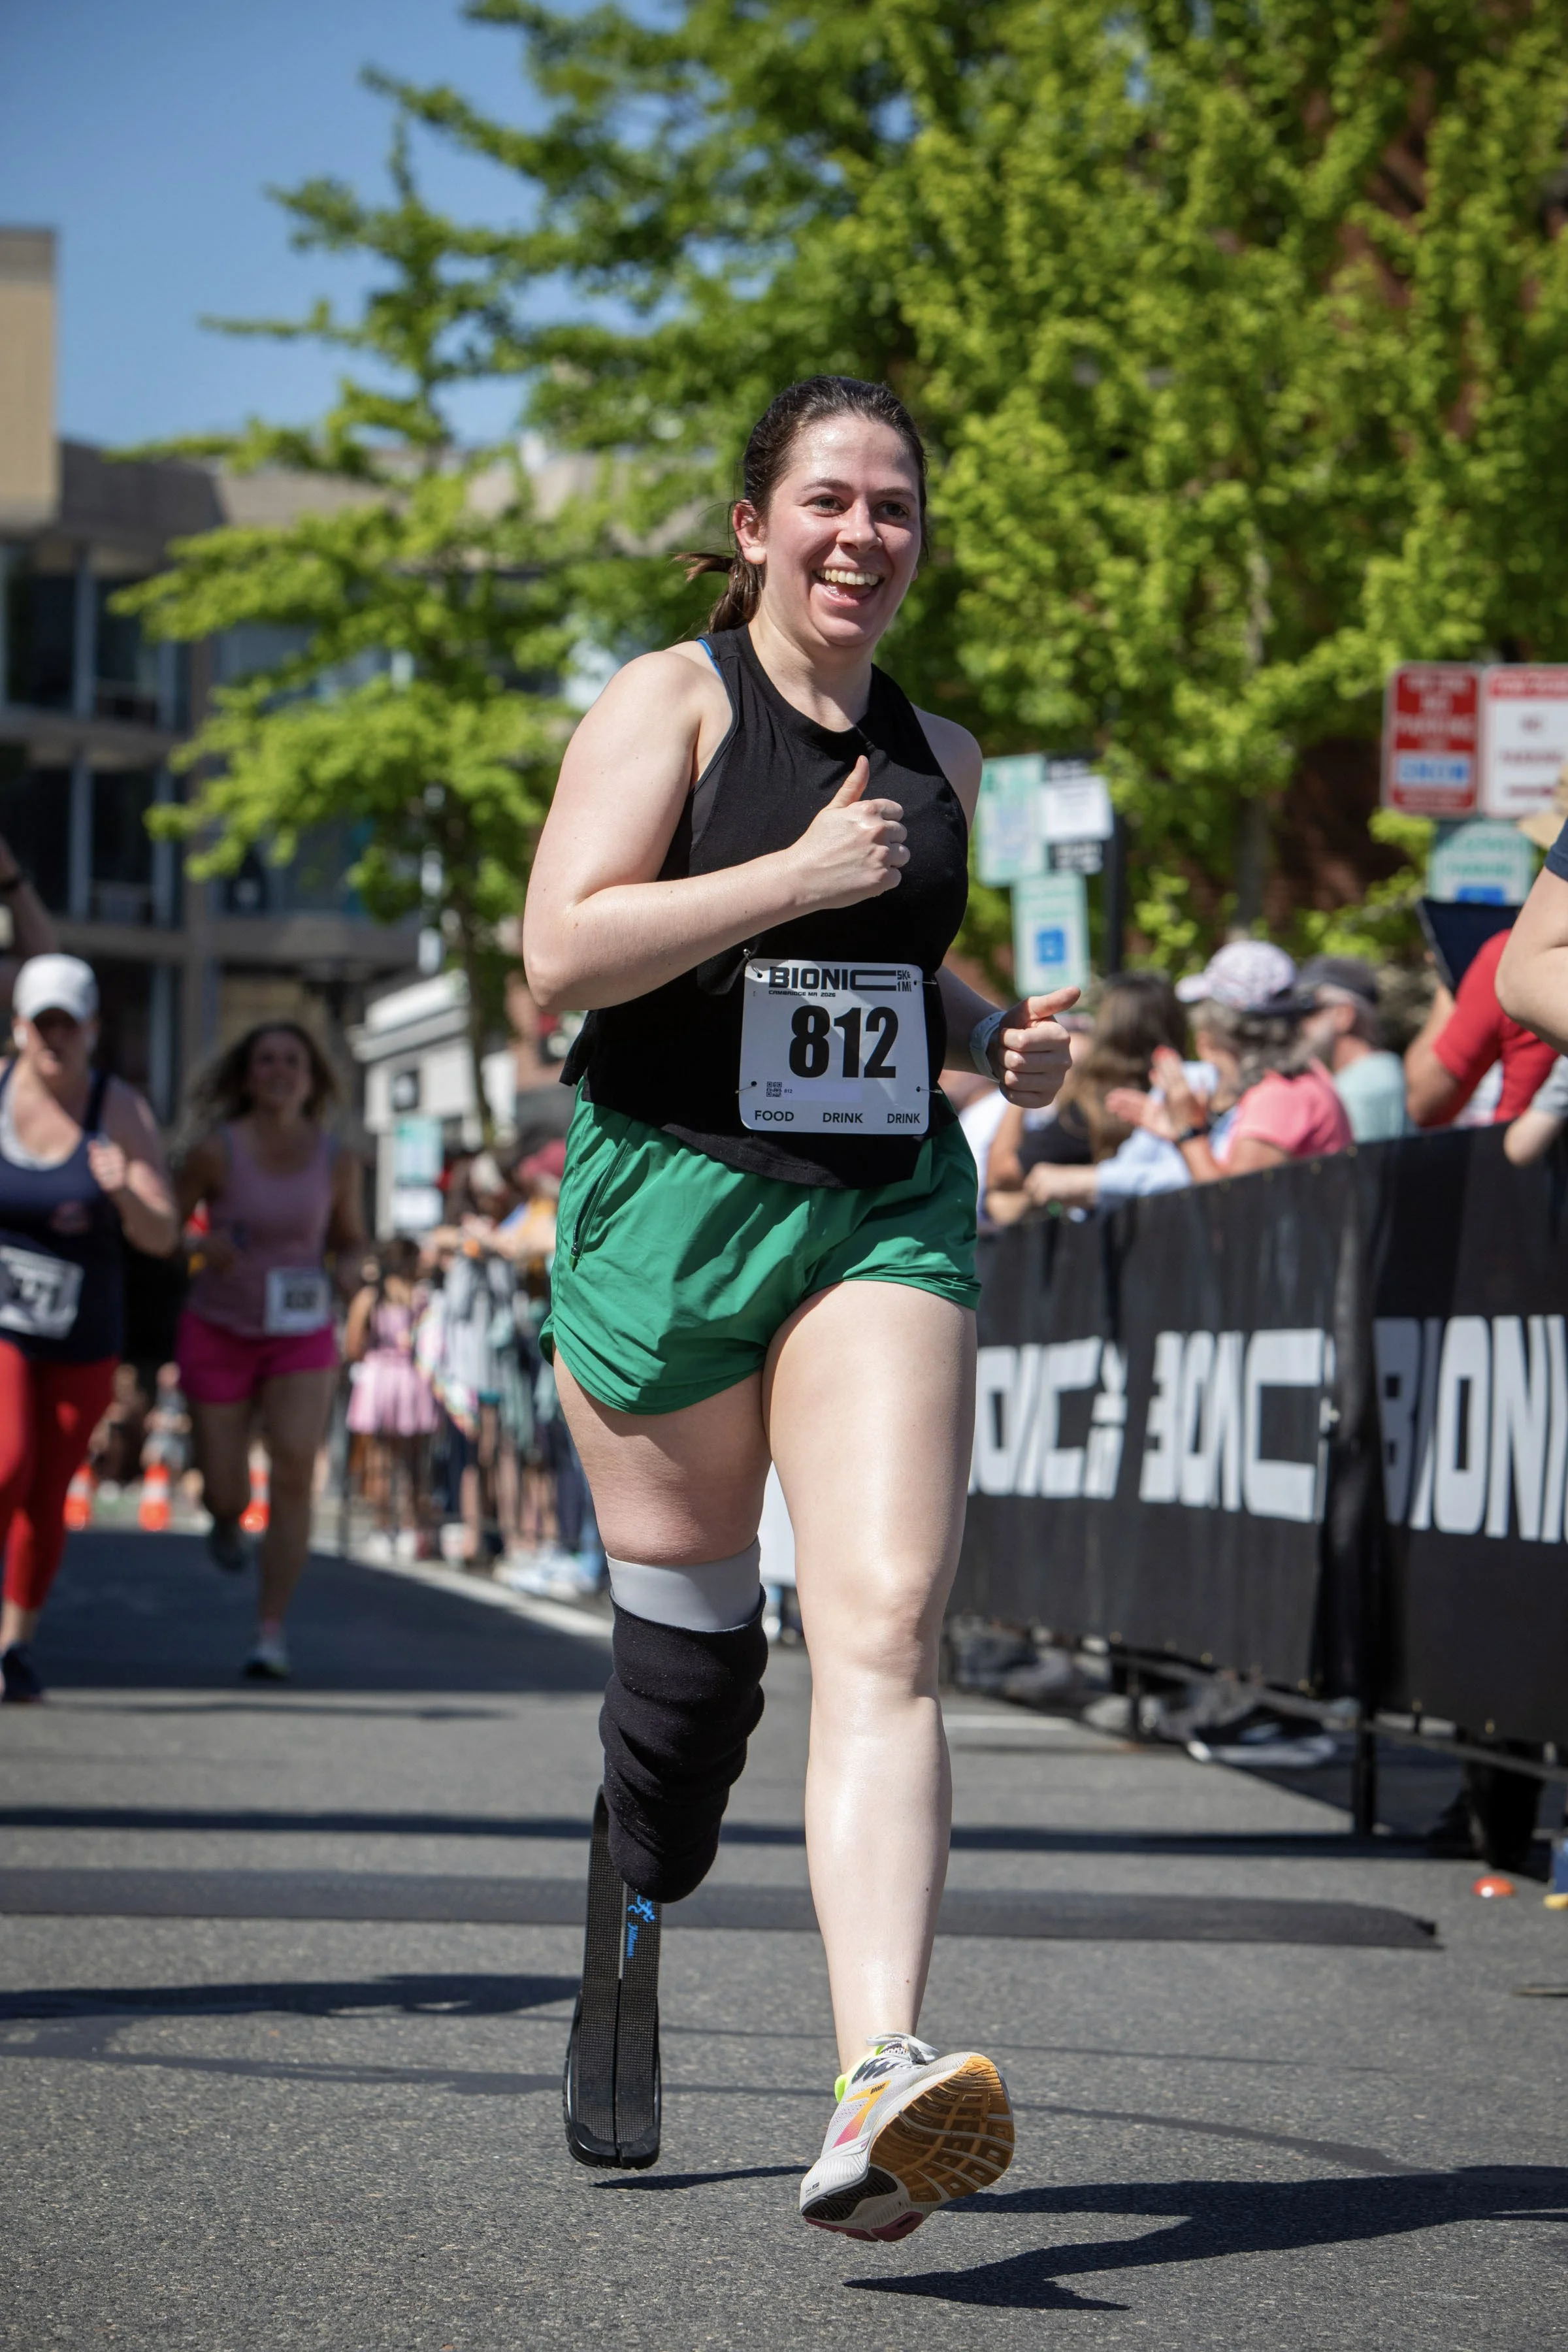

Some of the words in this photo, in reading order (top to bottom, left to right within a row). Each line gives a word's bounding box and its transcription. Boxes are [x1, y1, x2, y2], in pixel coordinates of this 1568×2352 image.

[769, 966, 897, 992] BIONIC
[789, 1005, 899, 1079] 812
[754, 1110, 794, 1122] FOOD
[822, 1113, 864, 1124] DRINK
[887, 1113, 921, 1124] DRINK
[1373, 1314, 1568, 1544] BIONI
